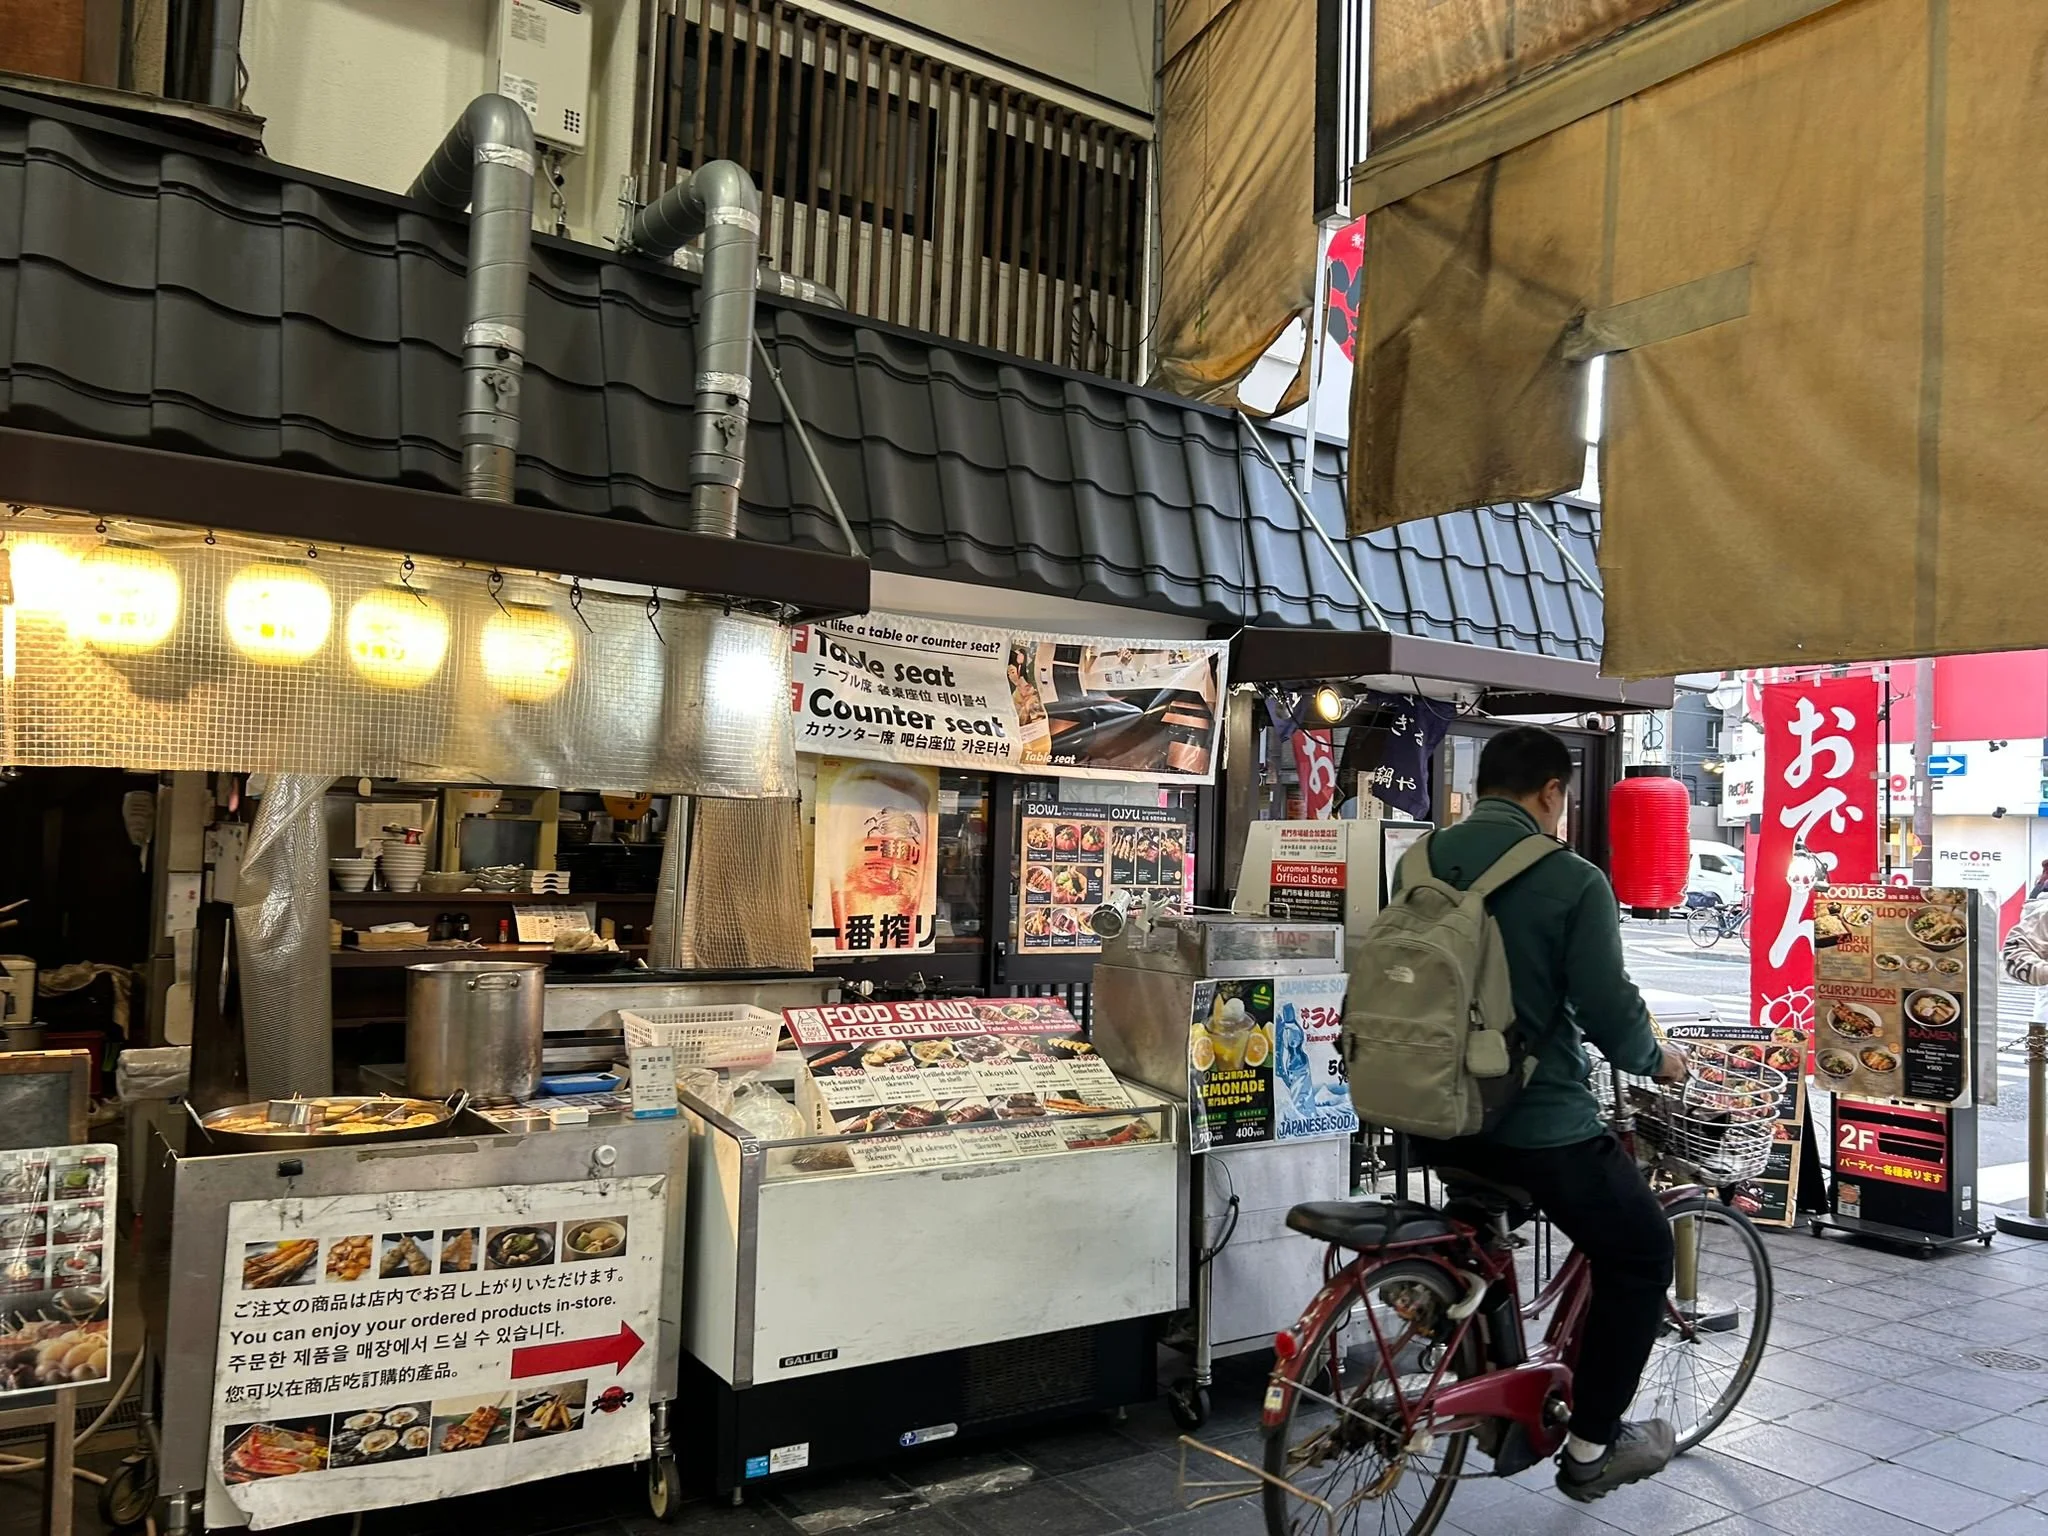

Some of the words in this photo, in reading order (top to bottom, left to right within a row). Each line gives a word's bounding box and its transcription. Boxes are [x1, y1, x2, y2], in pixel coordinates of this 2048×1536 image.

[831, 620, 853, 633] like
[857, 627, 866, 635] a
[869, 626, 902, 642] table
[906, 634, 918, 643] or
[922, 636, 968, 650] counter
[970, 642, 1000, 653] seat?
[814, 628, 885, 679] Table
[894, 663, 956, 687] seat
[813, 663, 872, 693] テーブル席
[937, 692, 987, 708] 테이블석
[809, 688, 936, 730] Counter
[945, 716, 1006, 737] seat
[805, 721, 895, 745] カウンター席
[900, 733, 955, 751] 吧台座位
[962, 739, 1010, 757] 카운터석
[1025, 750, 1052, 763] Table
[1055, 754, 1076, 764] seat
[1028, 804, 1061, 816] BOWL
[1111, 808, 1140, 820] OJYU
[864, 839, 920, 864] 一番搾り
[1940, 850, 2002, 861] ReCORE
[1277, 864, 1308, 873] Kuromon
[1311, 865, 1337, 874] Market
[1276, 873, 1309, 883] Official
[1312, 874, 1337, 884] Store
[1876, 907, 1919, 918] UDON
[811, 913, 936, 950] 一番搾り
[1837, 944, 1869, 953] UDON
[1329, 979, 1345, 993] SO
[1818, 984, 1859, 996] CURRY
[1861, 987, 1896, 999] UDON
[820, 1005, 893, 1025] FOOD
[895, 1001, 974, 1021] STAND
[835, 1026, 886, 1039] TAKE
[889, 1024, 924, 1035] OUT
[931, 1020, 982, 1034] MENU
[1672, 1027, 1709, 1037] BOWL
[1908, 1027, 1958, 1041] RAMEN
[1307, 1034, 1330, 1042] Ramune
[836, 1069, 864, 1077] ¥500
[888, 1065, 916, 1073] ¥500
[923, 1070, 945, 1078] Grilled
[977, 1069, 1018, 1080] Takoyaki
[1029, 1063, 1055, 1071] Grilled
[1197, 1079, 1265, 1098] LEMONADE
[1012, 1129, 1056, 1139] Yakitori
[1279, 1116, 1327, 1137] JAPANESE
[1330, 1115, 1356, 1130] SODA
[1840, 1124, 1874, 1151] 2F
[1840, 1157, 1942, 1184] パーティー各種承ります
[234, 1267, 624, 1318] ご注文の商品は店内でお召し上がりいただけます。
[230, 1331, 266, 1346] You
[273, 1328, 305, 1342] can
[312, 1322, 361, 1339] enjoy
[366, 1318, 407, 1334] your
[411, 1308, 476, 1327] ordered
[481, 1302, 551, 1323] products
[556, 1294, 616, 1312] in-store.
[228, 1351, 286, 1373] 주문한
[293, 1344, 349, 1366] 제품을
[357, 1336, 427, 1359] 매장에서
[433, 1331, 467, 1350] 드실
[473, 1329, 490, 1346] 수
[496, 1321, 564, 1344] 있습니다.
[785, 1350, 833, 1366] GALILEI
[225, 1361, 457, 1404] 您可以在商店吃訂購的產品。
